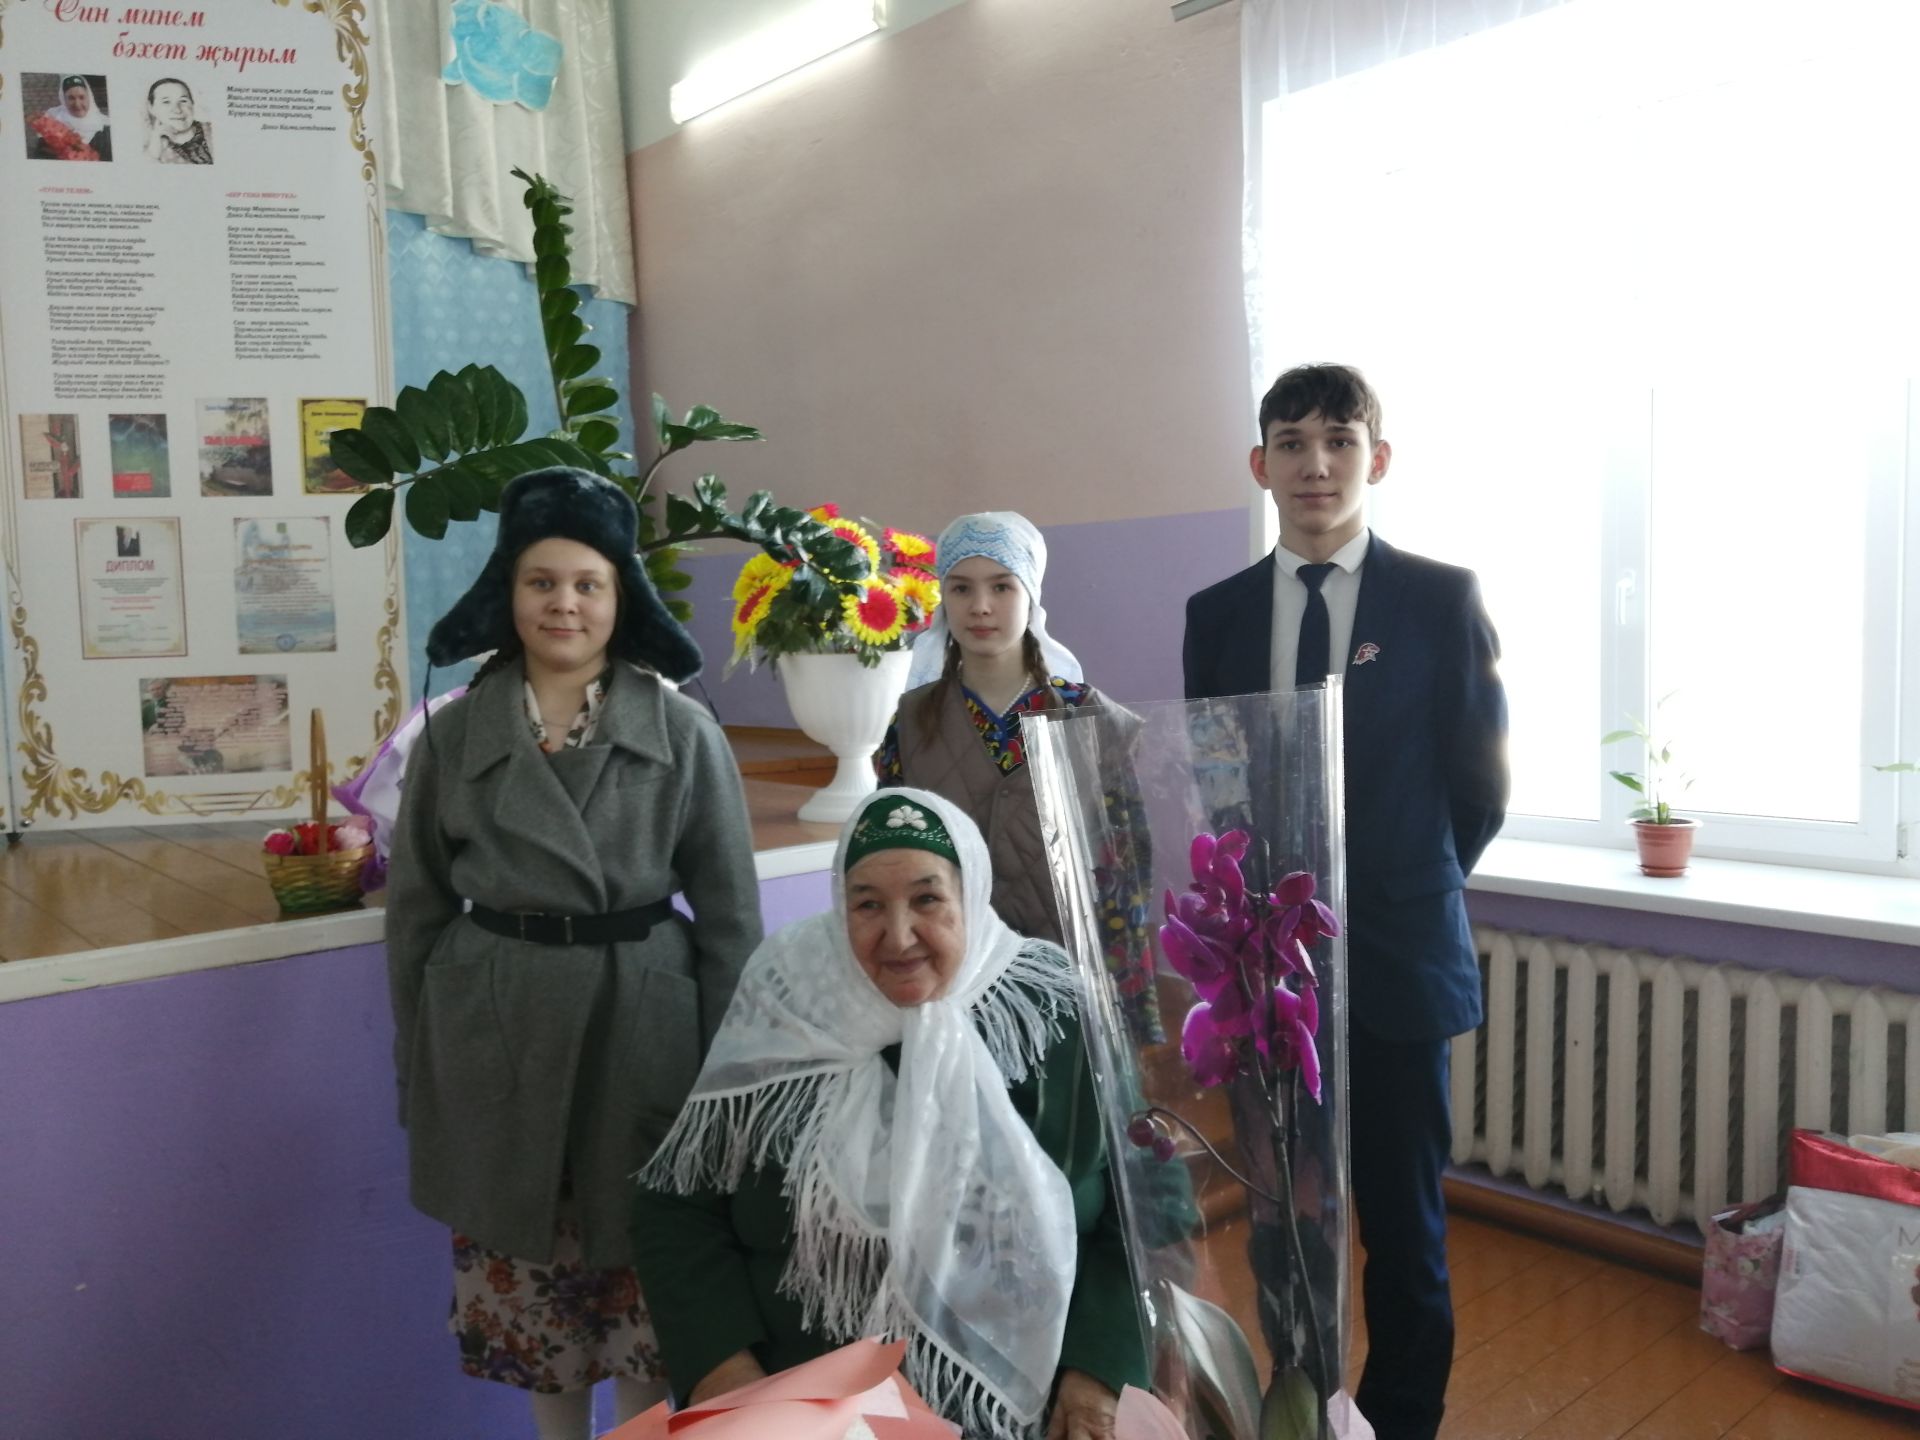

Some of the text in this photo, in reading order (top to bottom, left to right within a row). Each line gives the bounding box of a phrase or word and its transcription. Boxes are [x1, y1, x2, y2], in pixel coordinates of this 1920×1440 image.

[54, 0, 205, 27] Син минем
[112, 31, 297, 73] бәхет җырым
[105, 559, 155, 573] ДИПЛОМ
